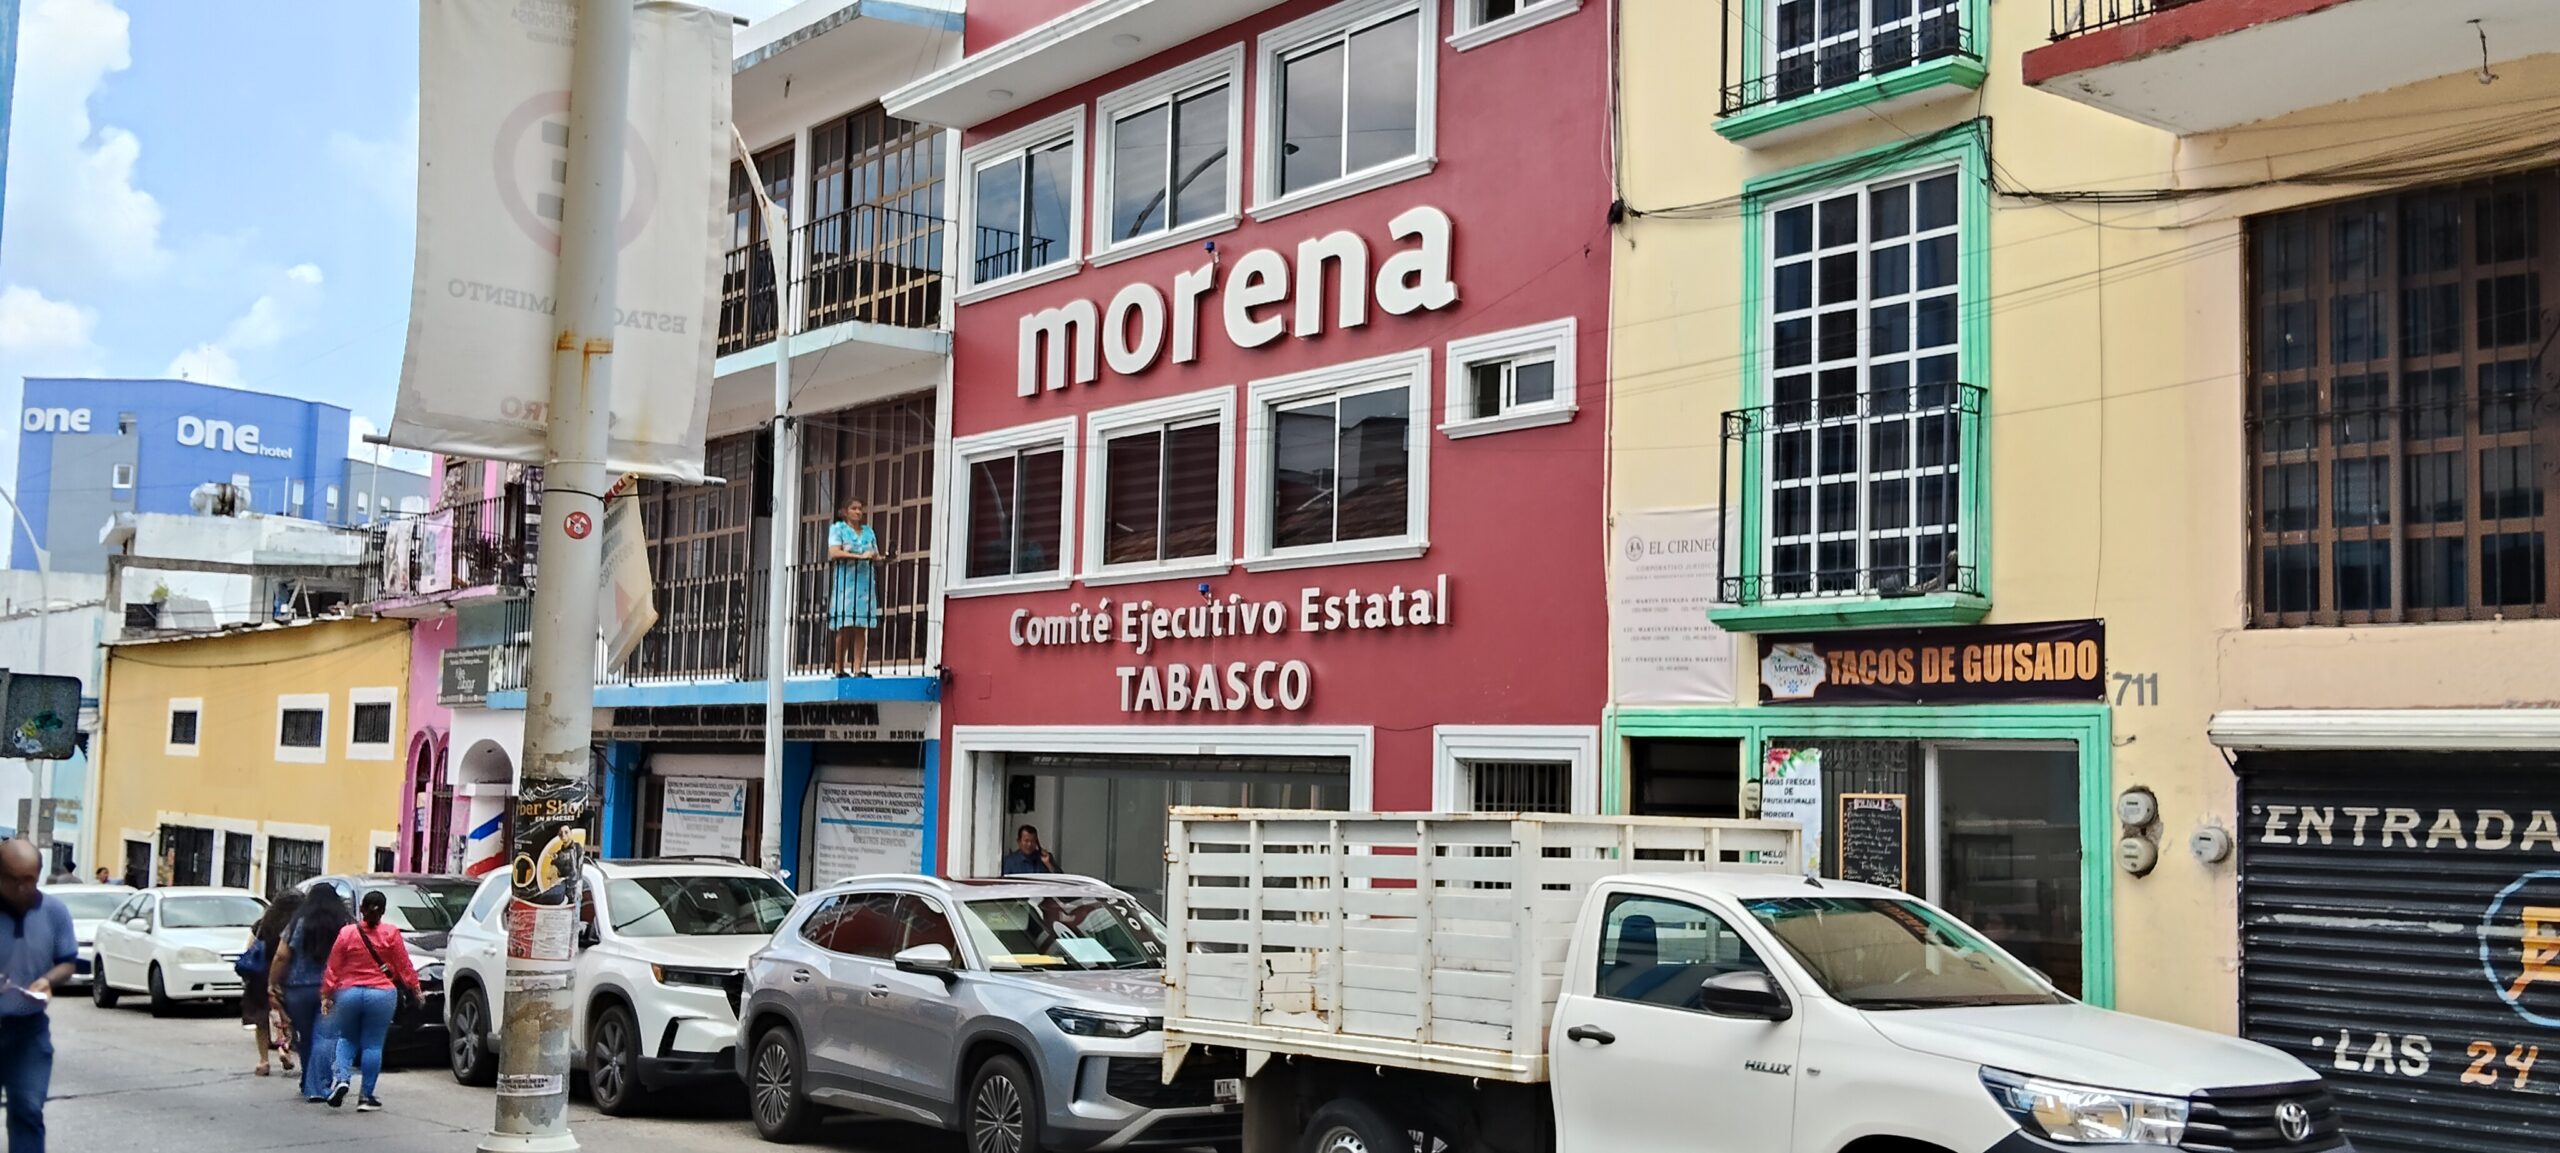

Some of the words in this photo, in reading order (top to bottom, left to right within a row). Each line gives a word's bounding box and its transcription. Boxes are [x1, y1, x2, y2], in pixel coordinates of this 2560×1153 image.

[1017, 205, 1459, 398] morena
[23, 406, 91, 433] one
[177, 415, 260, 454] one
[260, 444, 293, 460] hotel
[1649, 541, 1665, 556] EL
[1009, 598, 1113, 647] Comité
[1121, 593, 1287, 655] Ejecutivo
[1300, 574, 1452, 634] Estatal
[1827, 647, 1914, 687] TACOS
[1921, 645, 1956, 684] DE
[1962, 639, 2099, 683] GUISADO
[1116, 660, 1312, 713] TABASCO
[2112, 671, 2159, 707] 711
[1784, 787, 1794, 796] DE
[1785, 778, 1816, 786] FRESCAS
[546, 800, 584, 818] Shop
[2260, 805, 2560, 851] ENTRADA
[1744, 1060, 1793, 1076] HILUX
[2334, 1029, 2433, 1077] LAS
[2460, 1040, 2540, 1088] 24
